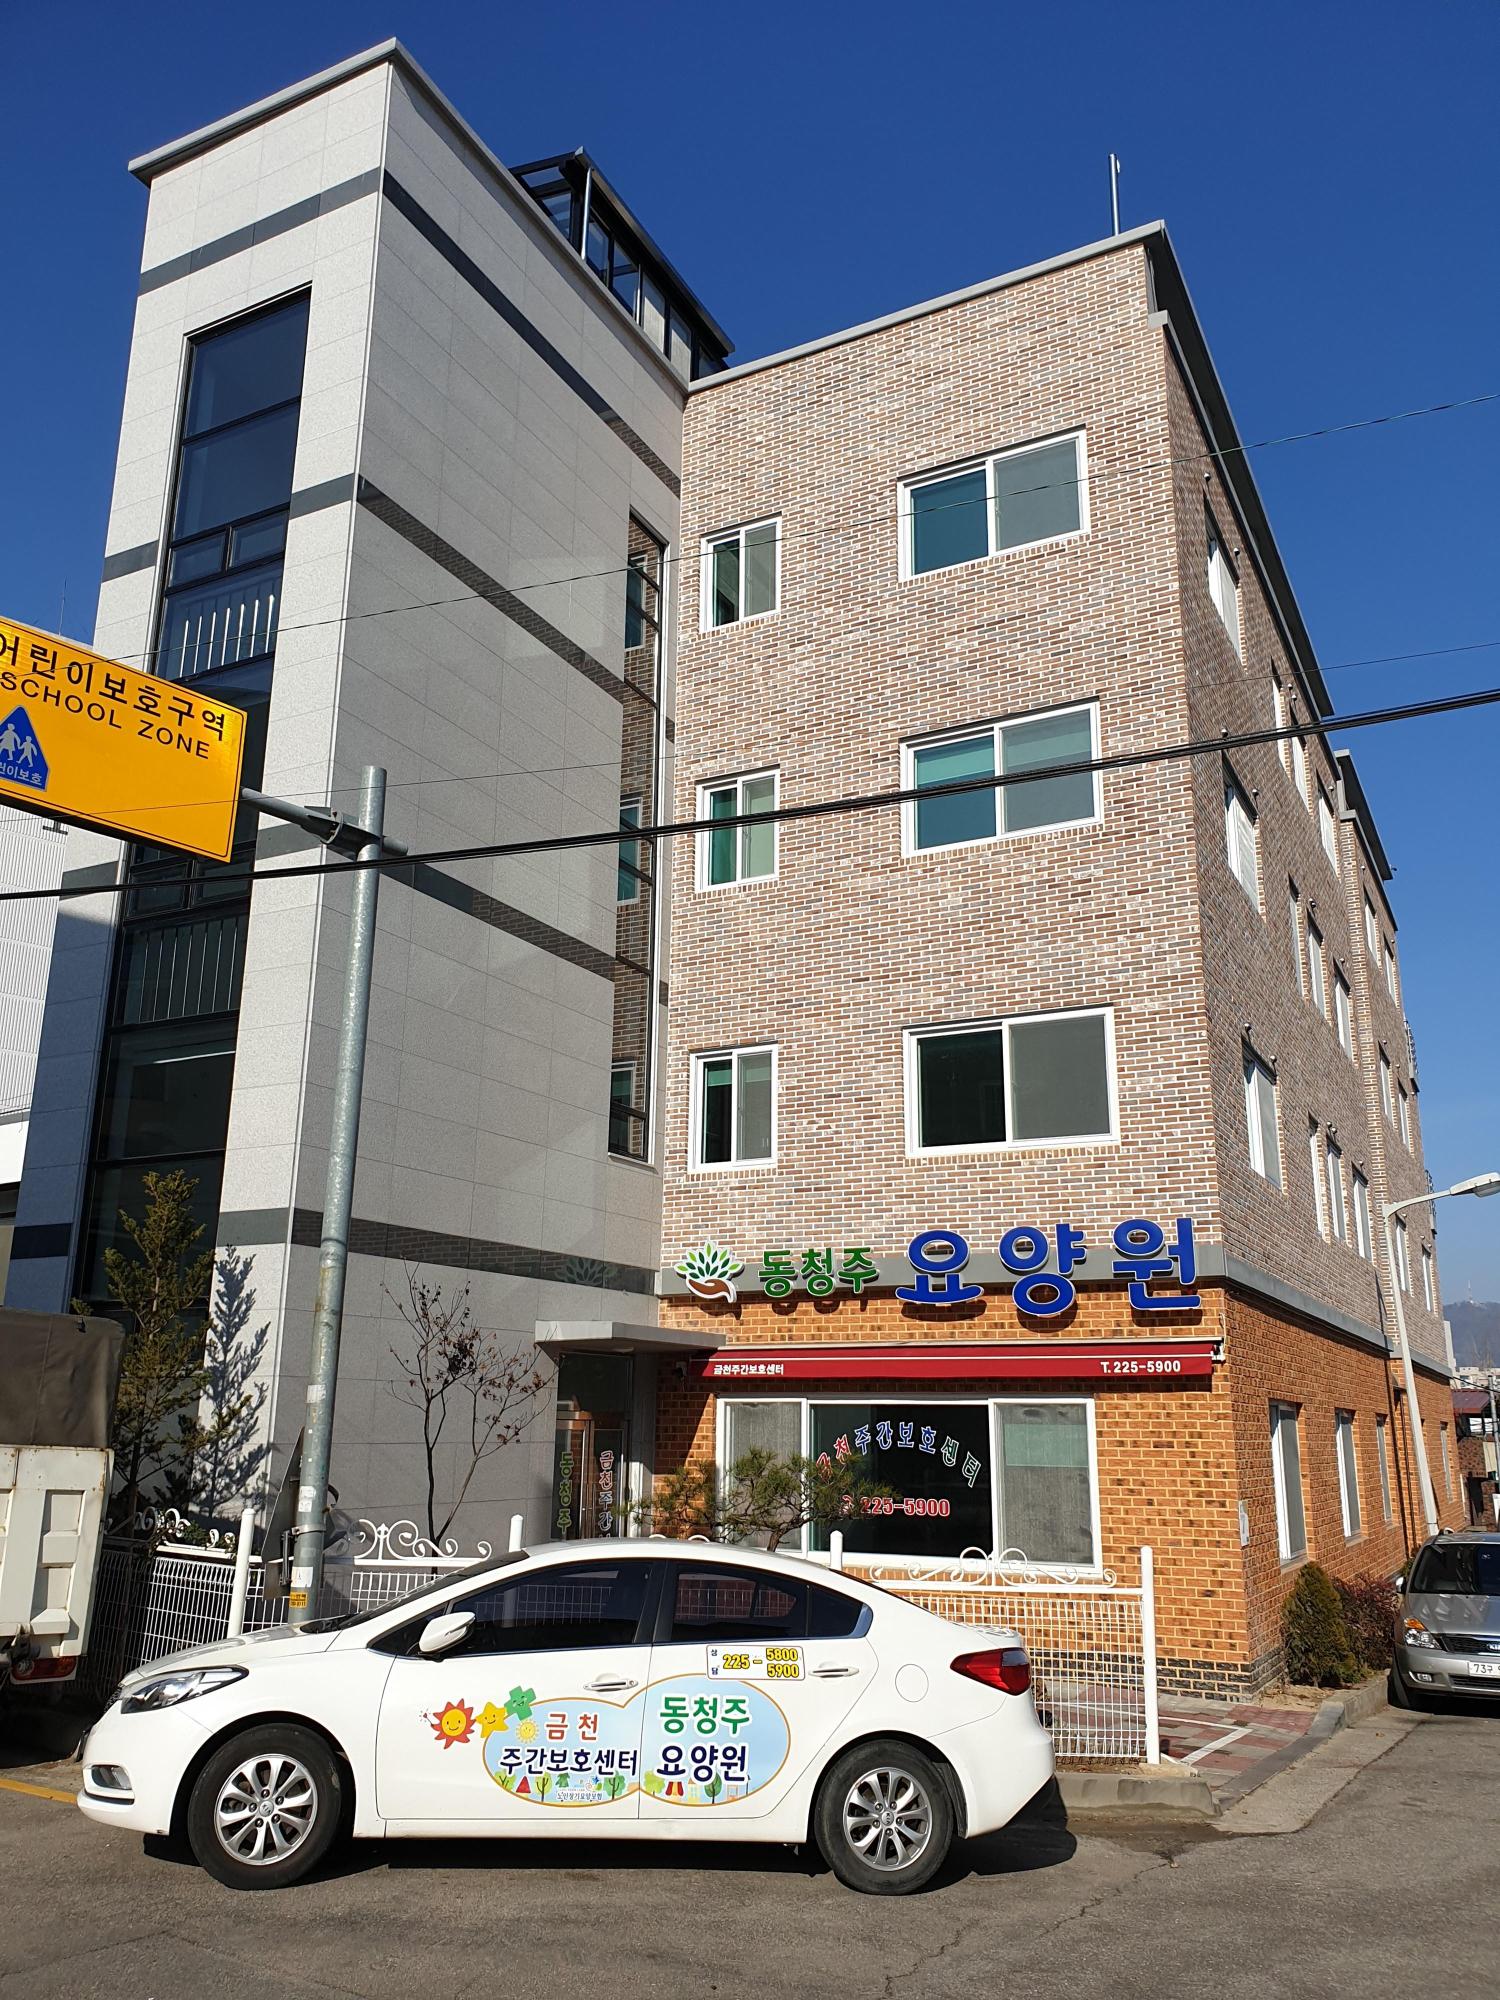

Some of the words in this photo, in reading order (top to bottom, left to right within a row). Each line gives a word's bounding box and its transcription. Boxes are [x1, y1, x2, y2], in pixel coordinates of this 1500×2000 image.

[0, 633, 225, 741] 어린이보호구역
[1, 671, 122, 729] SCHOOL
[137, 719, 210, 760] ZONE
[757, 1247, 879, 1298] 동청주
[895, 1217, 1201, 1315] 요양원
[713, 1364, 784, 1375] 금천주간보호센터
[557, 1452, 574, 1534] 동청주
[599, 1450, 614, 1537] 금천주간
[860, 1497, 950, 1517] 225-5900
[765, 1647, 798, 1661] 5800
[766, 1663, 800, 1677] 5900
[660, 1696, 750, 1735] 동청주
[500, 1748, 638, 1776] 주간보호센터
[656, 1745, 746, 1782] 요양원
